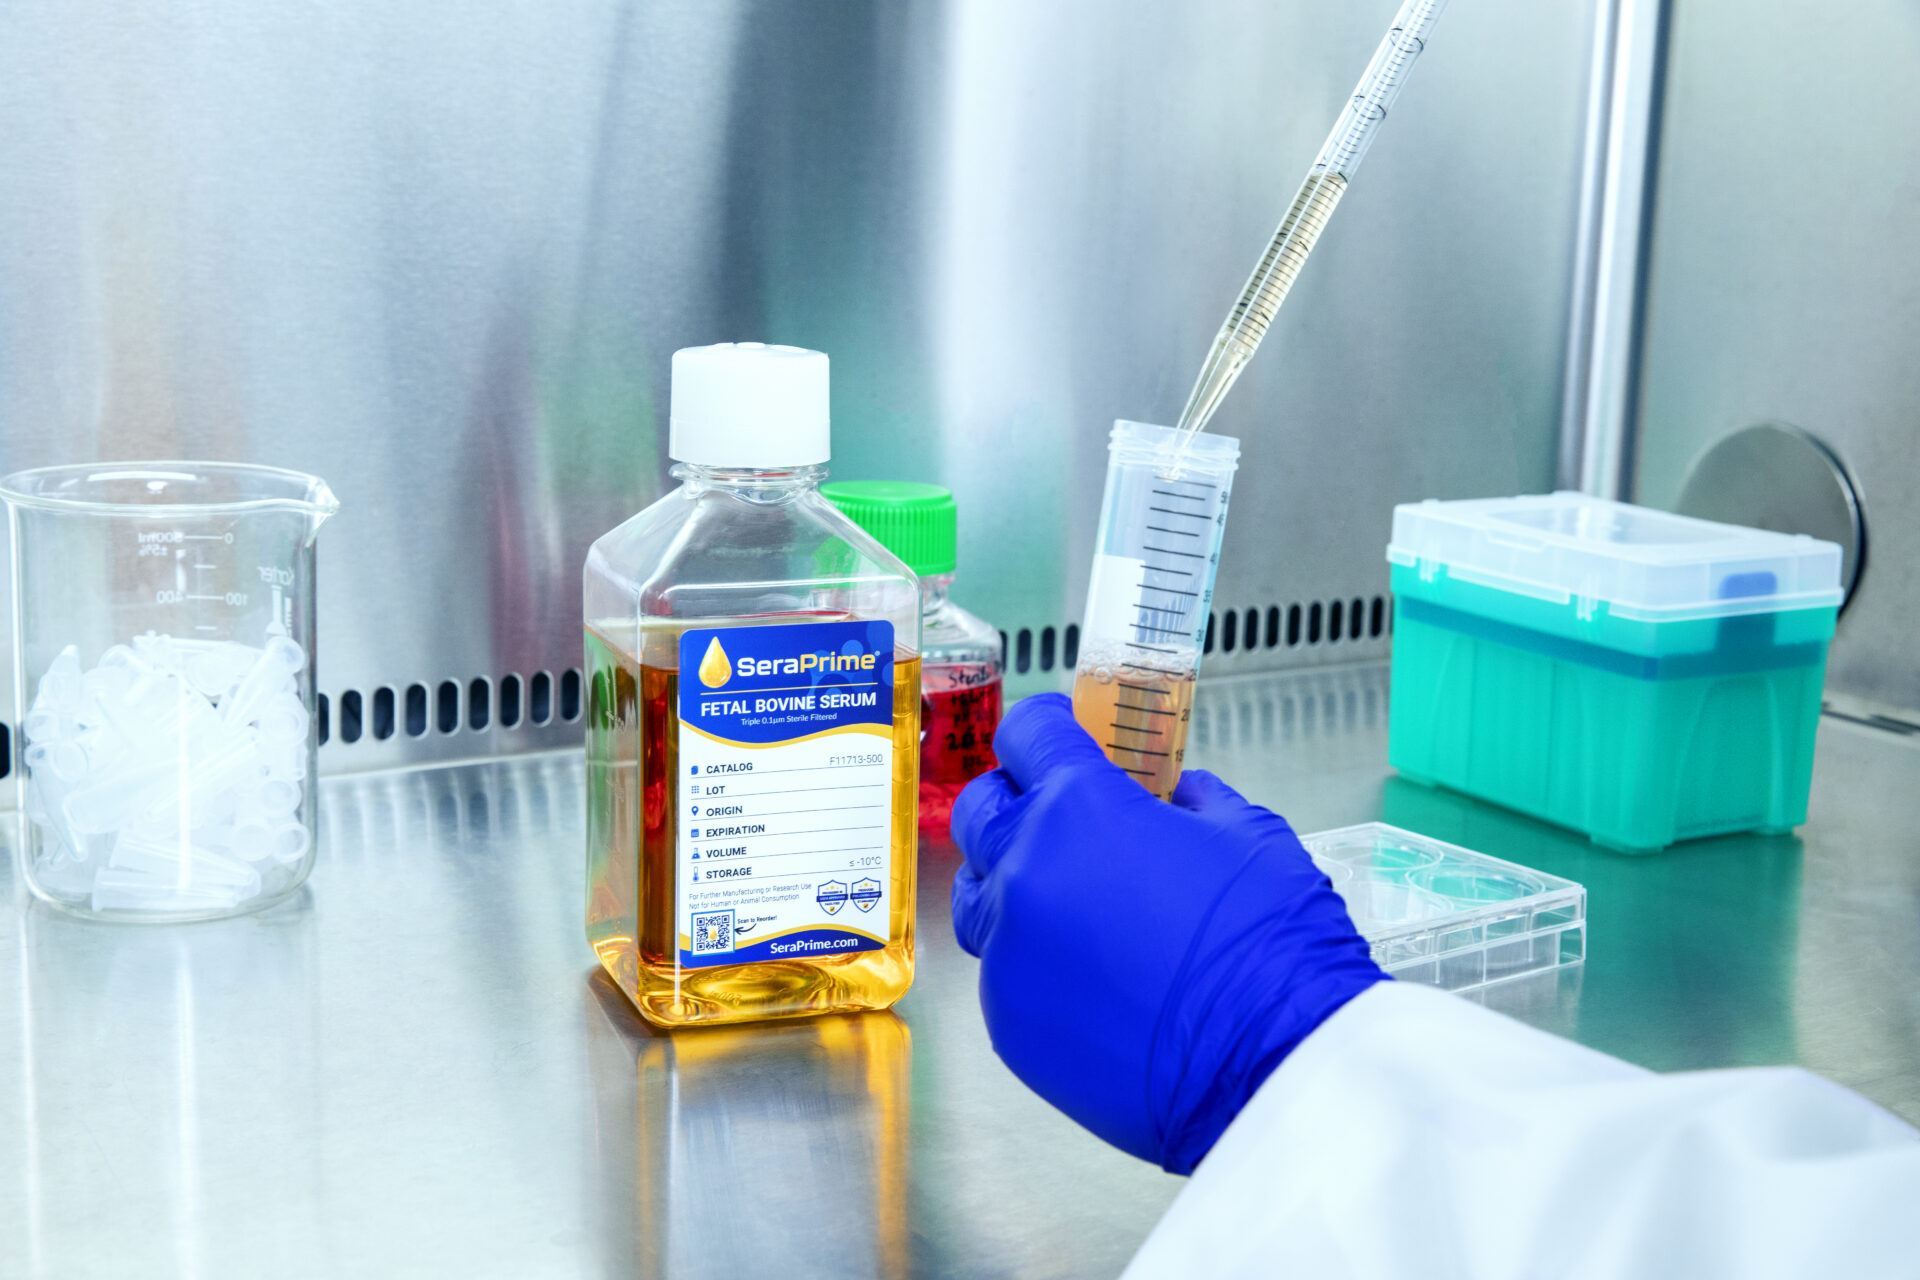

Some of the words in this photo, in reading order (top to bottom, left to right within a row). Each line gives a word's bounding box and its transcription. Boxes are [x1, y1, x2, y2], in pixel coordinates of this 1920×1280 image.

[701, 700, 751, 717] FETAL
[756, 695, 816, 713] BOVINE
[819, 692, 876, 709] SERUM
[741, 717, 761, 727] Triple
[786, 713, 809, 723] Sterile
[810, 712, 837, 722] Filtered
[706, 762, 753, 774] CATALOG
[829, 754, 883, 766] F11713-500
[706, 786, 725, 795] LOT
[706, 805, 743, 817] ORIGIN
[706, 824, 765, 838] EXPIRATION
[706, 847, 747, 858] VOLUME
[706, 867, 752, 879] STORAGE
[700, 891, 721, 899] Further
[722, 887, 764, 897] Manufacturing
[772, 884, 799, 892] Research
[761, 893, 800, 903] Consumption
[770, 937, 858, 954] SeraPrime.com
